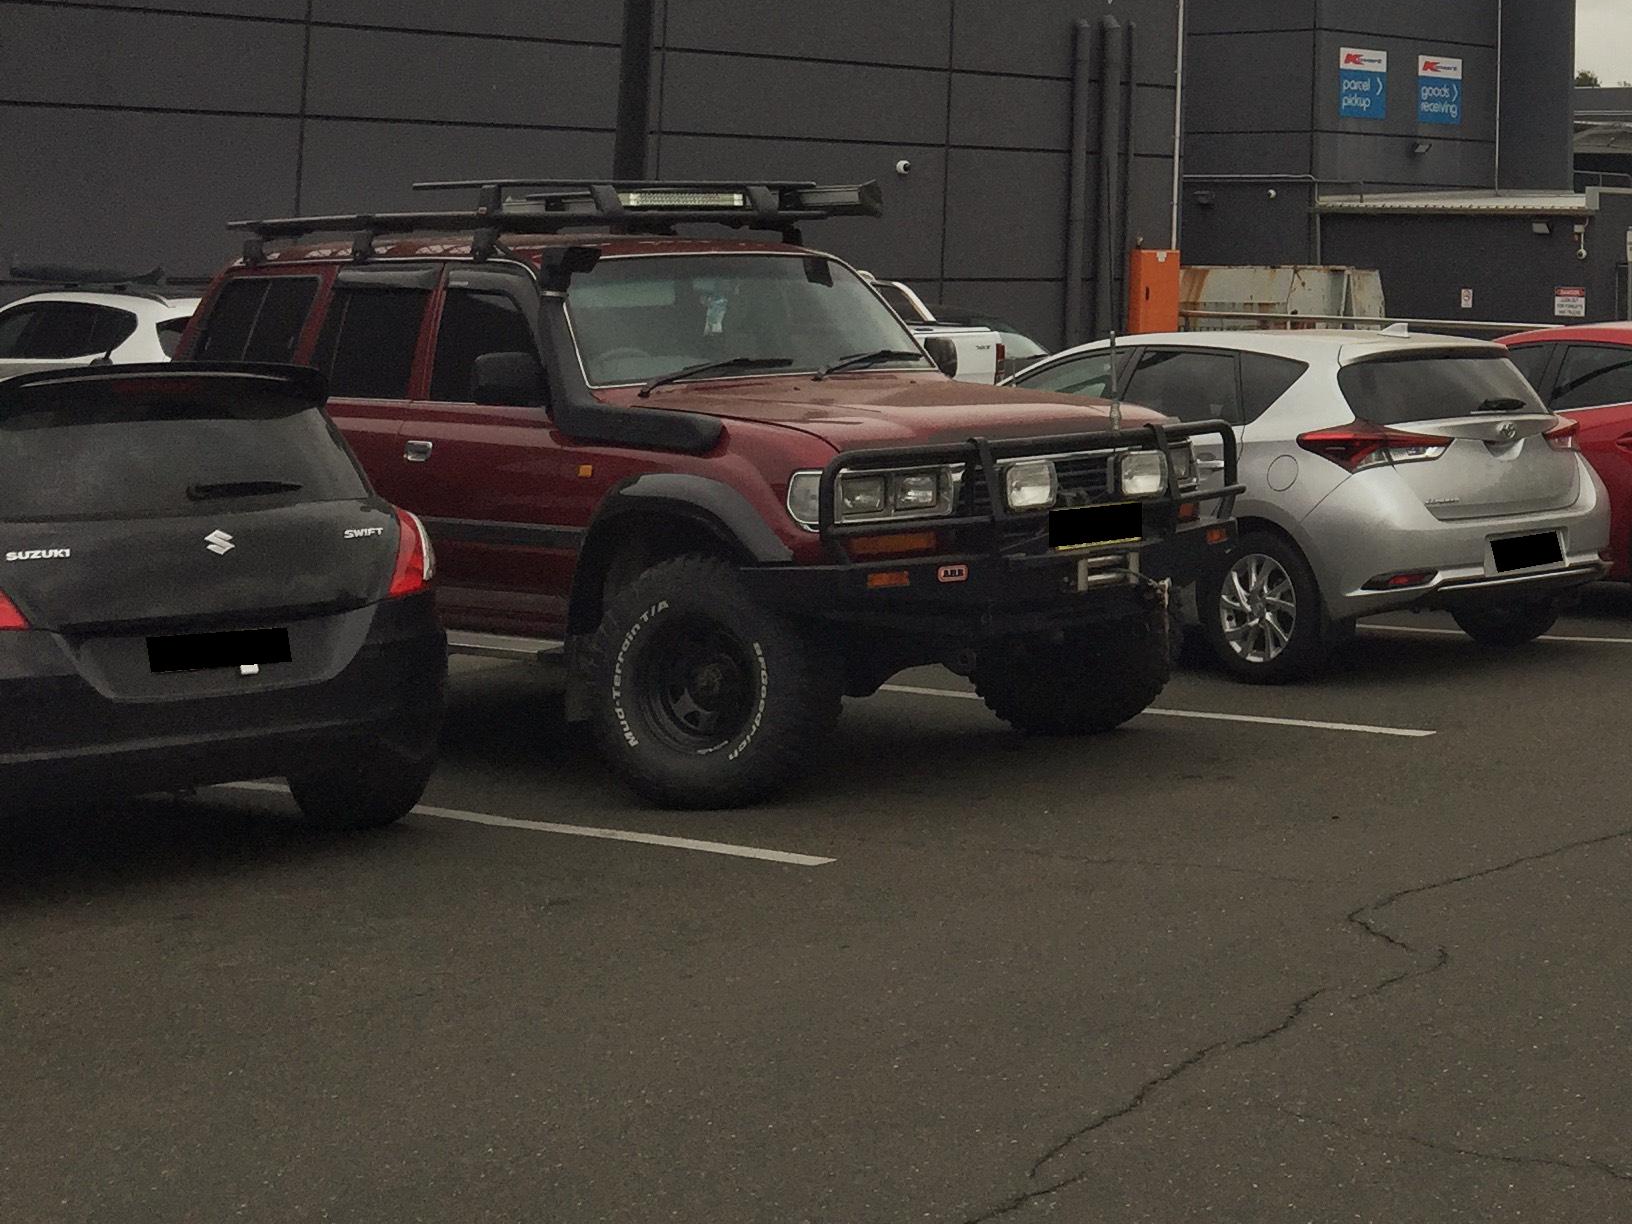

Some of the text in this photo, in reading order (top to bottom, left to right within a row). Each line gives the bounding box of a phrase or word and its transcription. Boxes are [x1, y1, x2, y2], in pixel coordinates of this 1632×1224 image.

[1342, 78, 1371, 92] parcel
[1421, 84, 1450, 100] goods
[1341, 93, 1371, 111] pickup
[1421, 100, 1457, 118] receiving
[344, 527, 384, 539] SWIFT
[6, 548, 70, 561] SUZUKI
[612, 600, 669, 747] Mud-Terrain T/A
